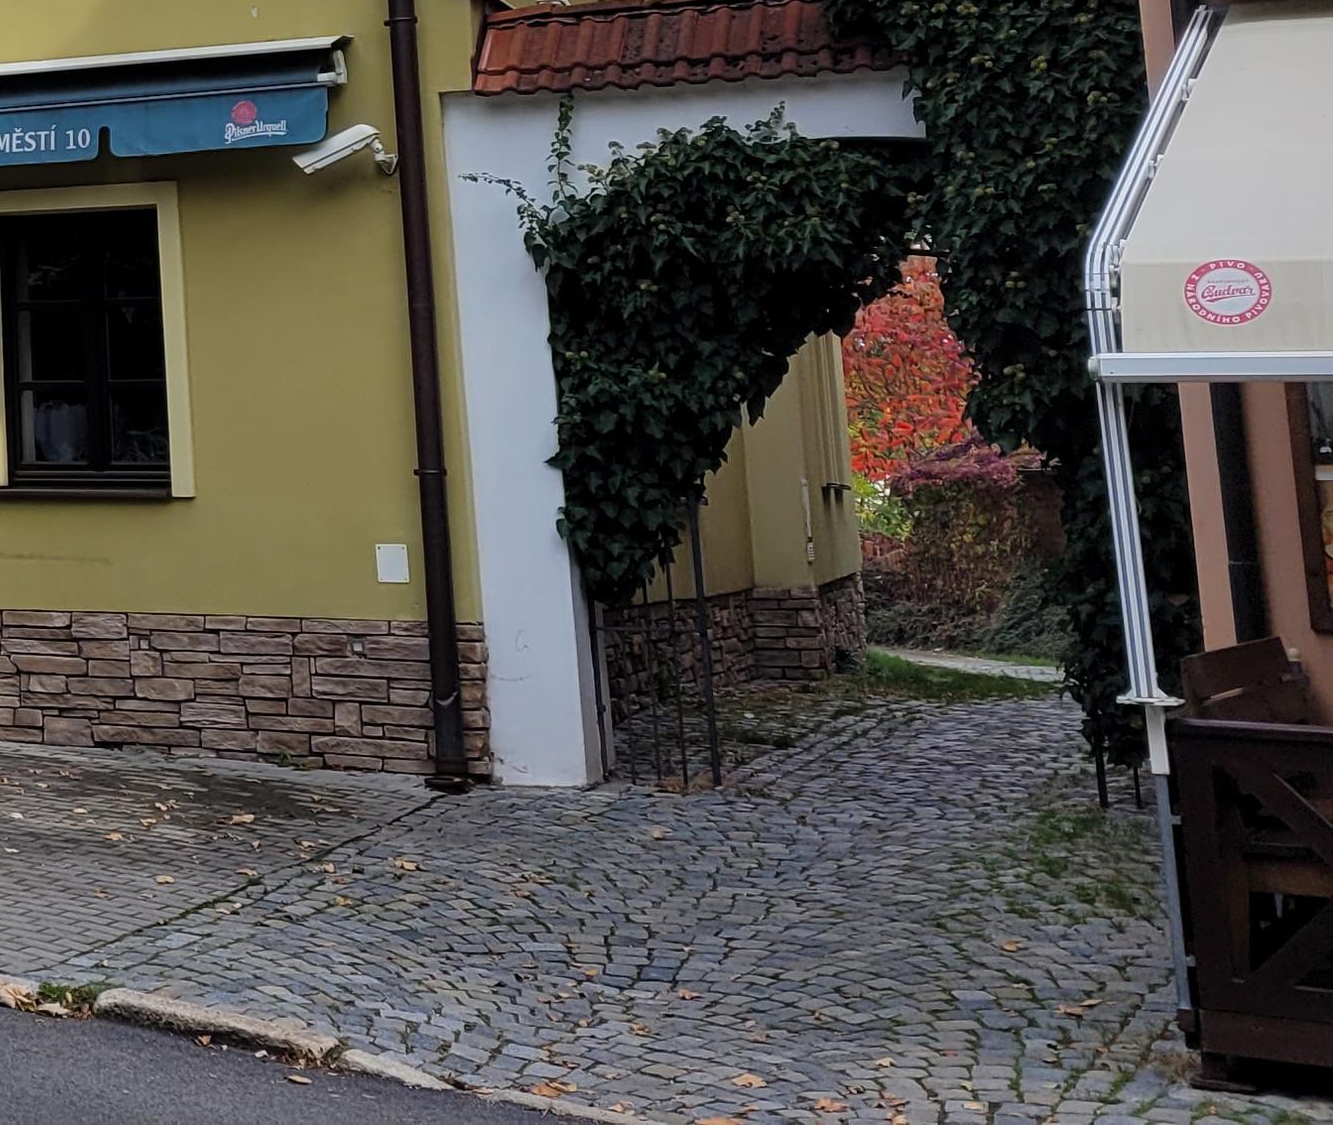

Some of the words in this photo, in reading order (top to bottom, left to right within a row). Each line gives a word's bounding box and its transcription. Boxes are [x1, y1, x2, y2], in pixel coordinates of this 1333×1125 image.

[66, 129, 90, 150] 10
[224, 123, 256, 145] Pilsner
[255, 120, 287, 137] Urquell
[1209, 261, 1245, 271] PIVO
[1186, 284, 1241, 323] NÁRODNÍHO
[1245, 271, 1270, 319] PIVOVARU
